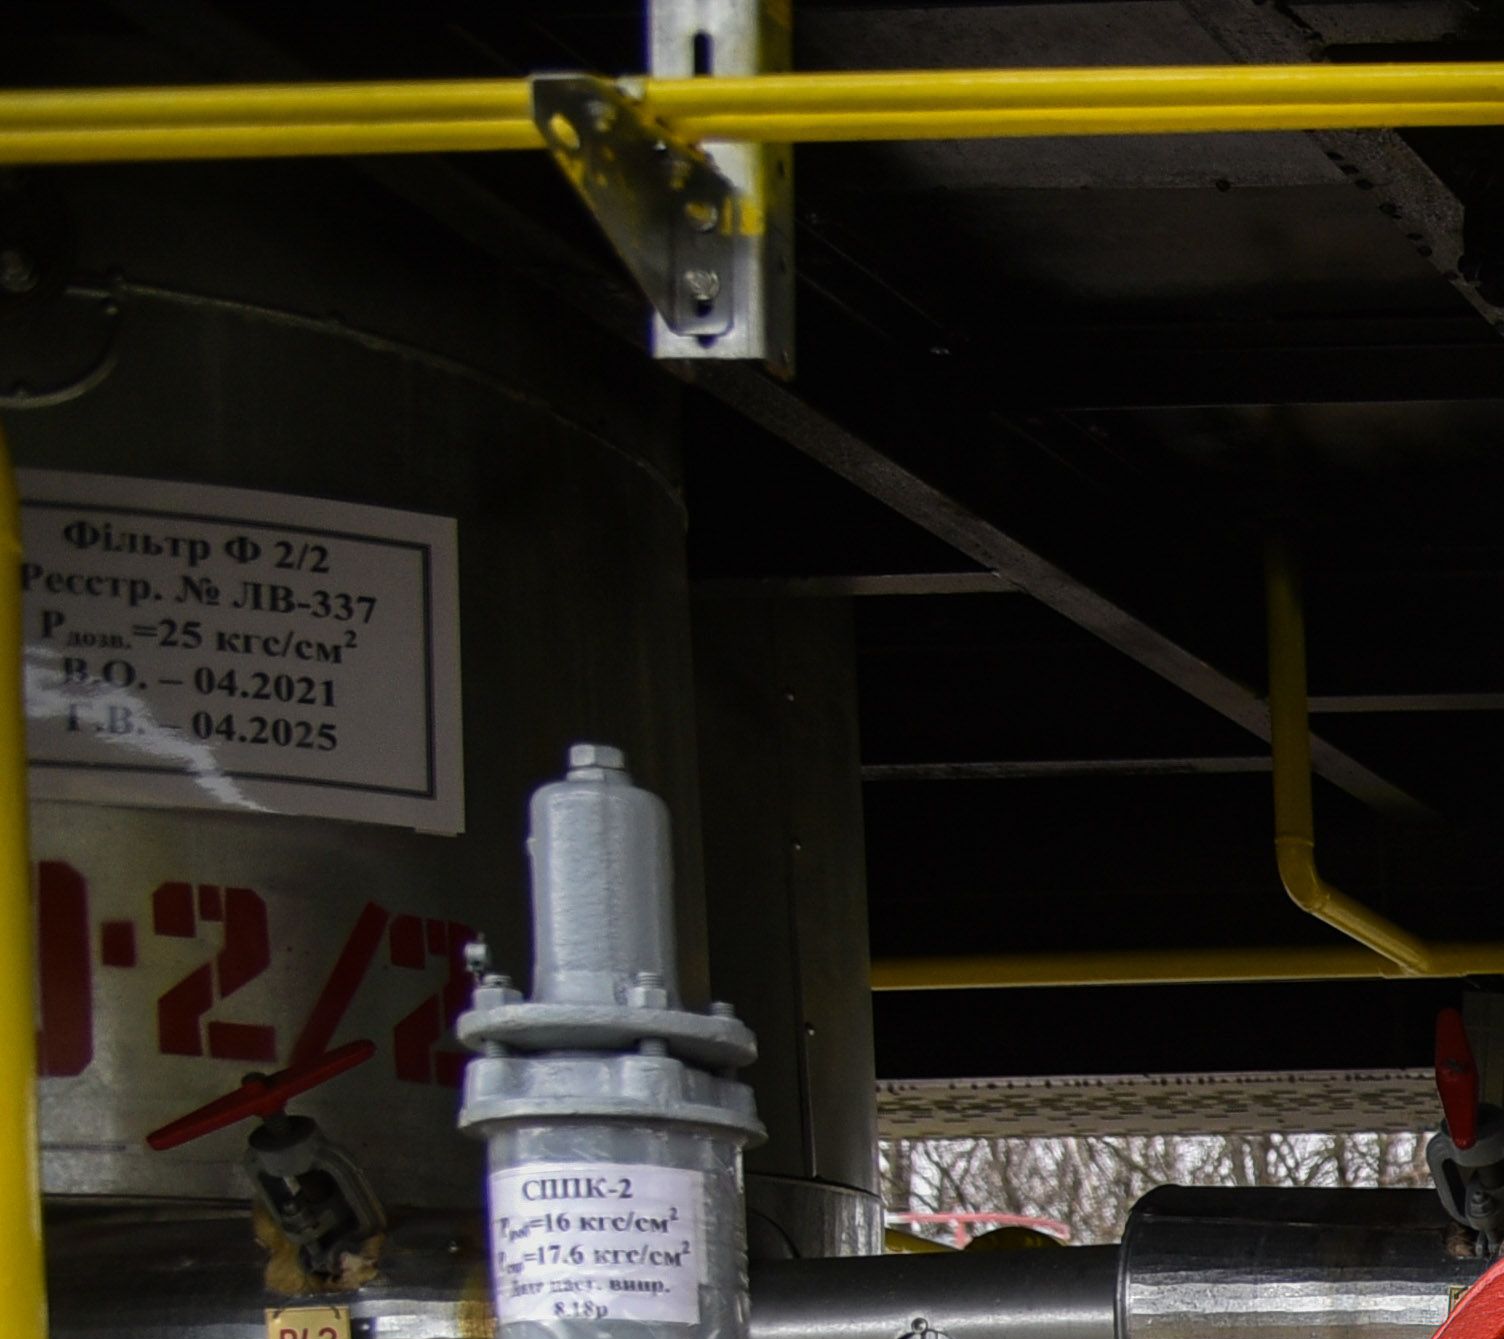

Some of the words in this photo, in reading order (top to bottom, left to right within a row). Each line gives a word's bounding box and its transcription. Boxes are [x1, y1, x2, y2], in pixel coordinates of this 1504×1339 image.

[64, 520, 210, 567] Фільтр
[224, 536, 261, 564] Ф
[274, 541, 331, 574] 2/2
[175, 574, 221, 607] №
[233, 581, 377, 624] ЛВ-337
[194, 666, 336, 708] 04.2021
[191, 711, 337, 751] 04.2025
[522, 1178, 633, 1201] СППК-2
